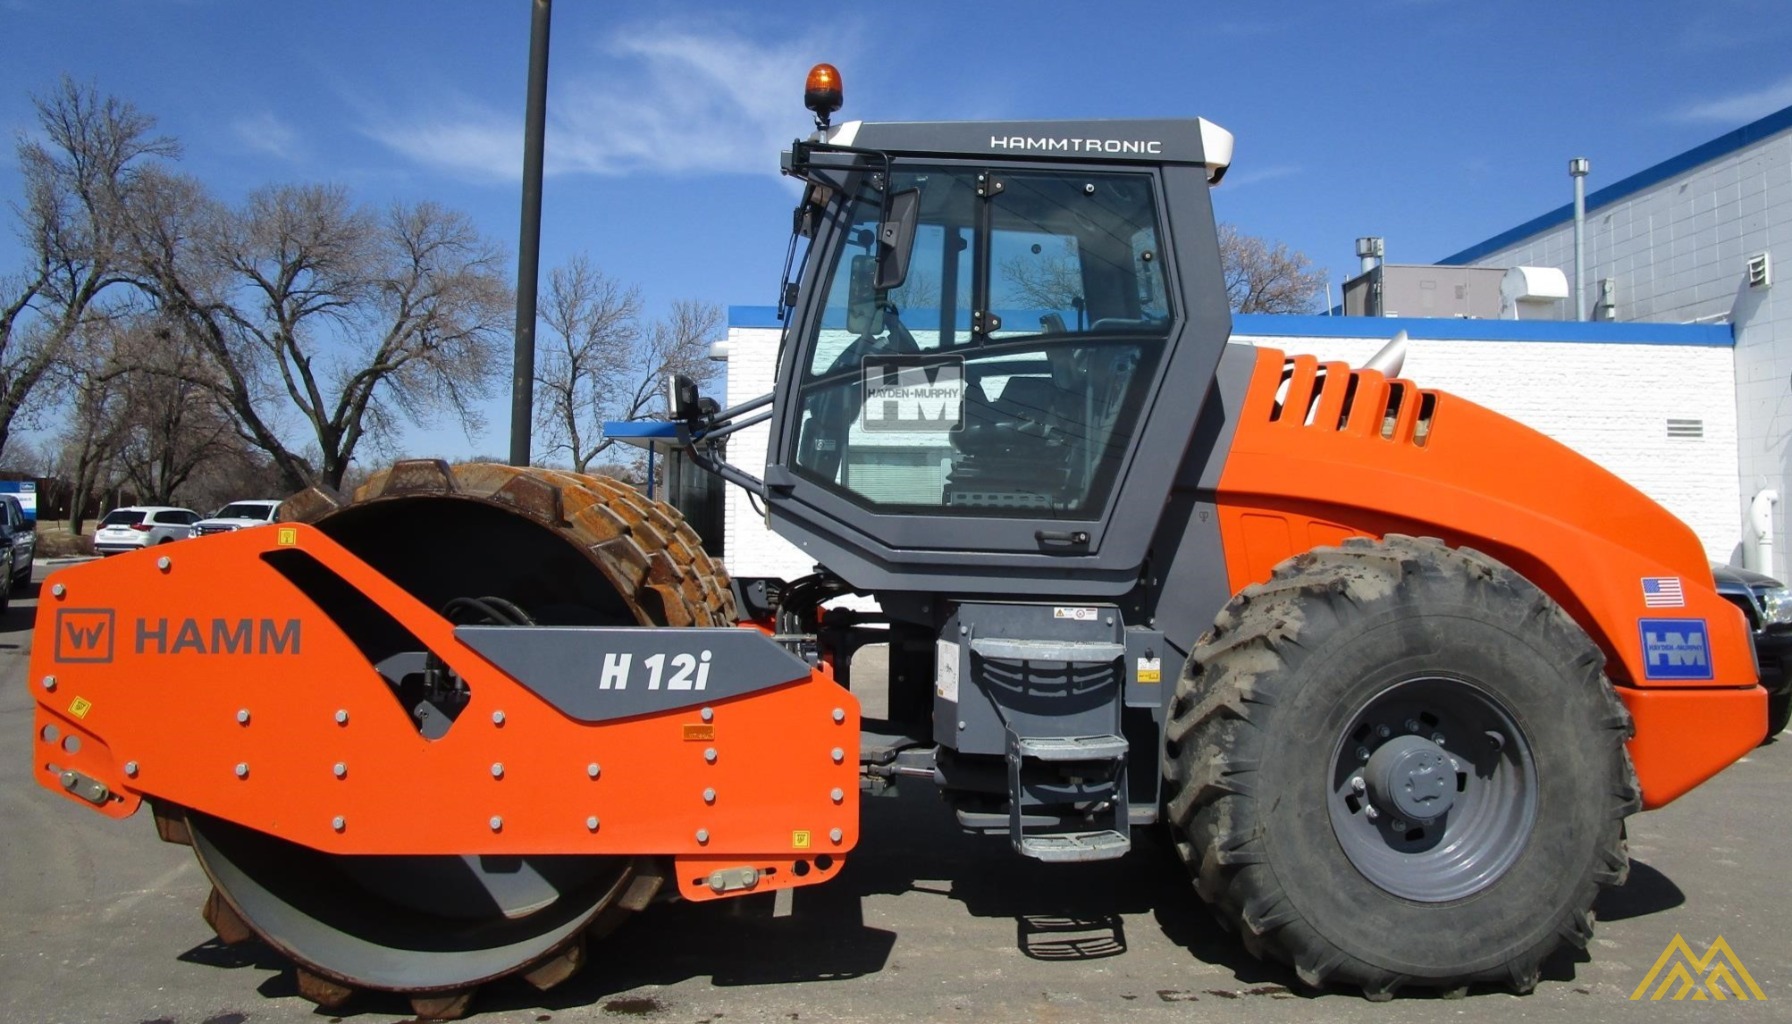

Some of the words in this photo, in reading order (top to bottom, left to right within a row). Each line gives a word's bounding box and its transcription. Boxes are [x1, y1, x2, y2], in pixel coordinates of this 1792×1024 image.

[990, 136, 1162, 154] HAMMTRONIC
[135, 618, 302, 655] HAMM
[1646, 632, 1706, 666] HM
[599, 653, 633, 690] H
[644, 649, 712, 691] 12i
